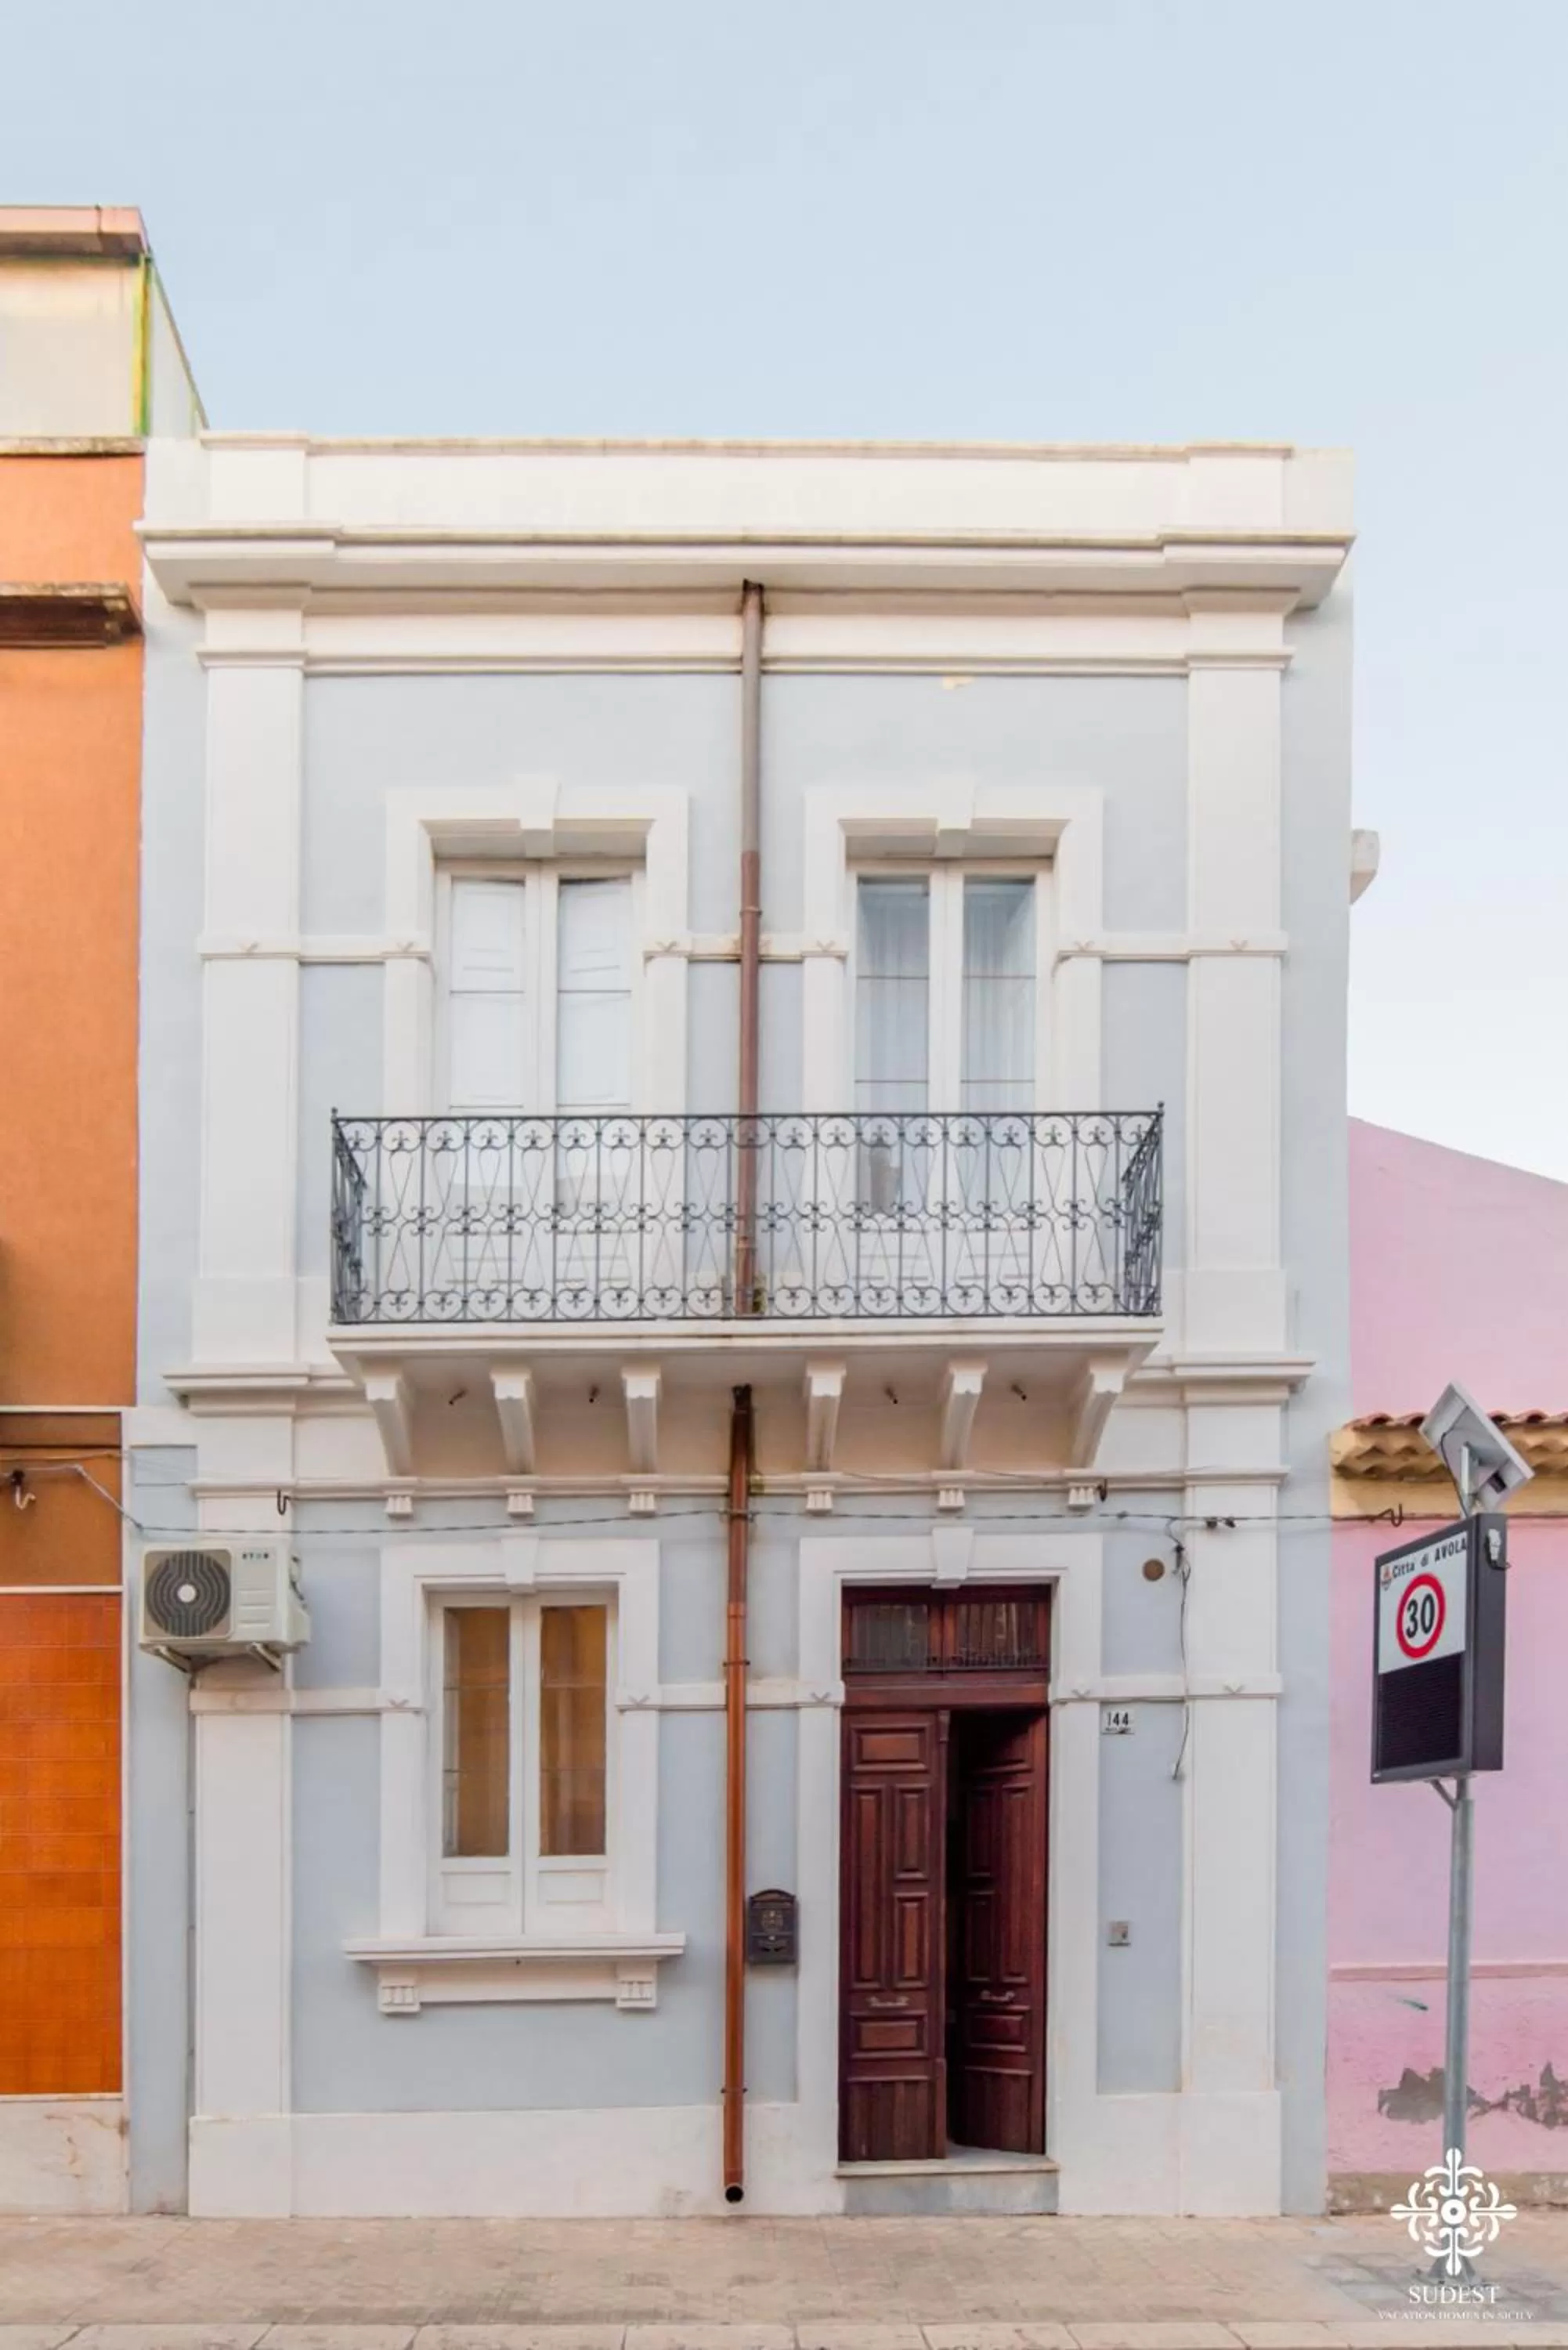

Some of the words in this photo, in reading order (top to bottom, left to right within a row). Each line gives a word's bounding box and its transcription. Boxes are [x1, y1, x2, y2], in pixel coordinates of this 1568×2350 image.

[1434, 1538, 1467, 1561] AVOLA
[1406, 1593, 1435, 1638] 30
[1107, 1712, 1129, 1726] 144
